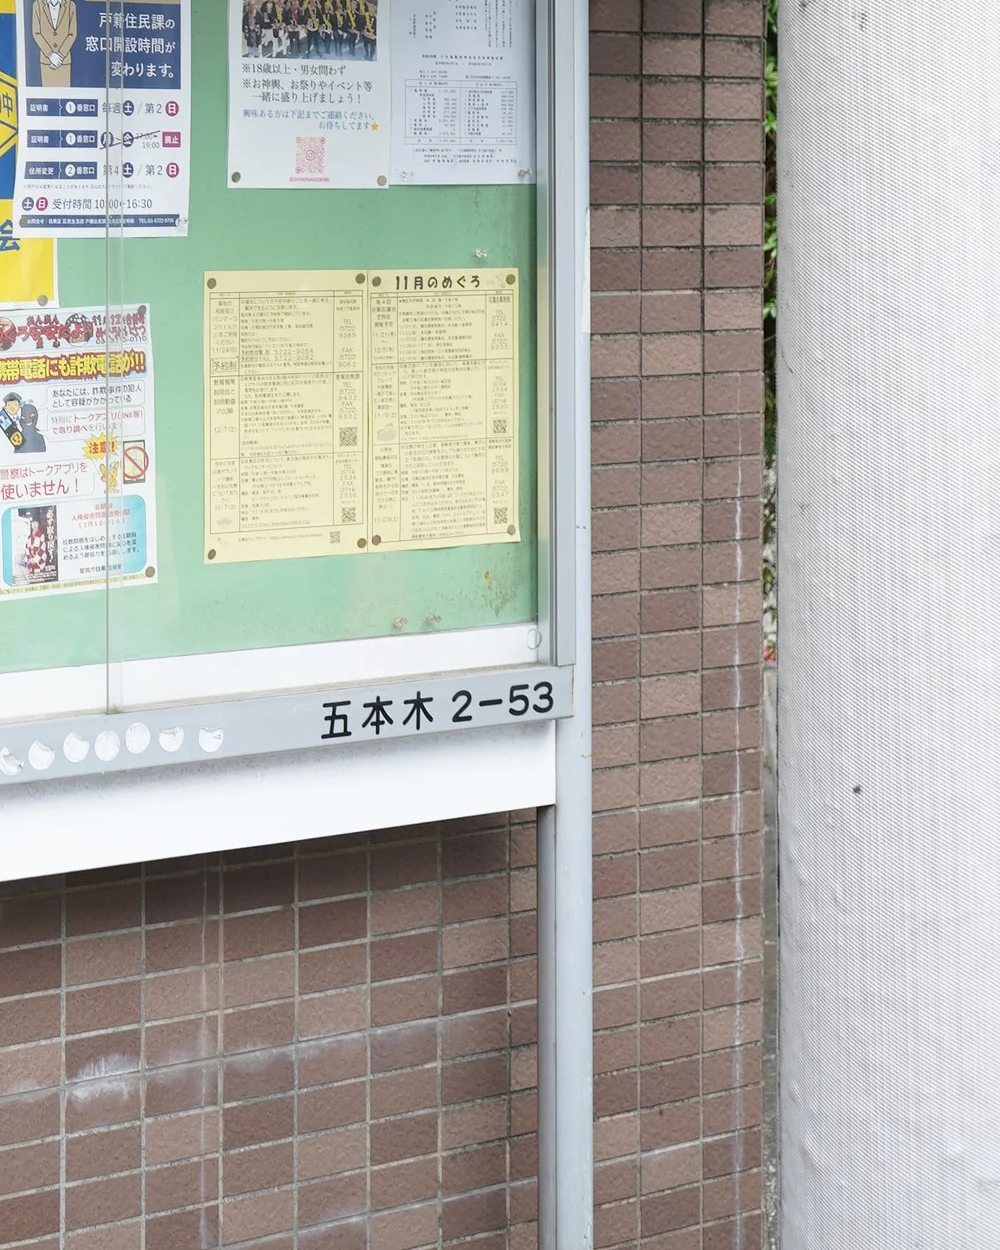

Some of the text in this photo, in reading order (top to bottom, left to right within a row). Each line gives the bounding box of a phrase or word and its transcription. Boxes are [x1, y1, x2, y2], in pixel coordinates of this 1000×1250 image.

[85, 36, 176, 54] 窓口開設時間が
[111, 61, 174, 79] 変わります。
[52, 199, 92, 210] 受付時間
[396, 275, 481, 290] 11月のめぐろ
[0, 462, 87, 481] 警察はトークアプリを
[321, 691, 434, 739] 五本木
